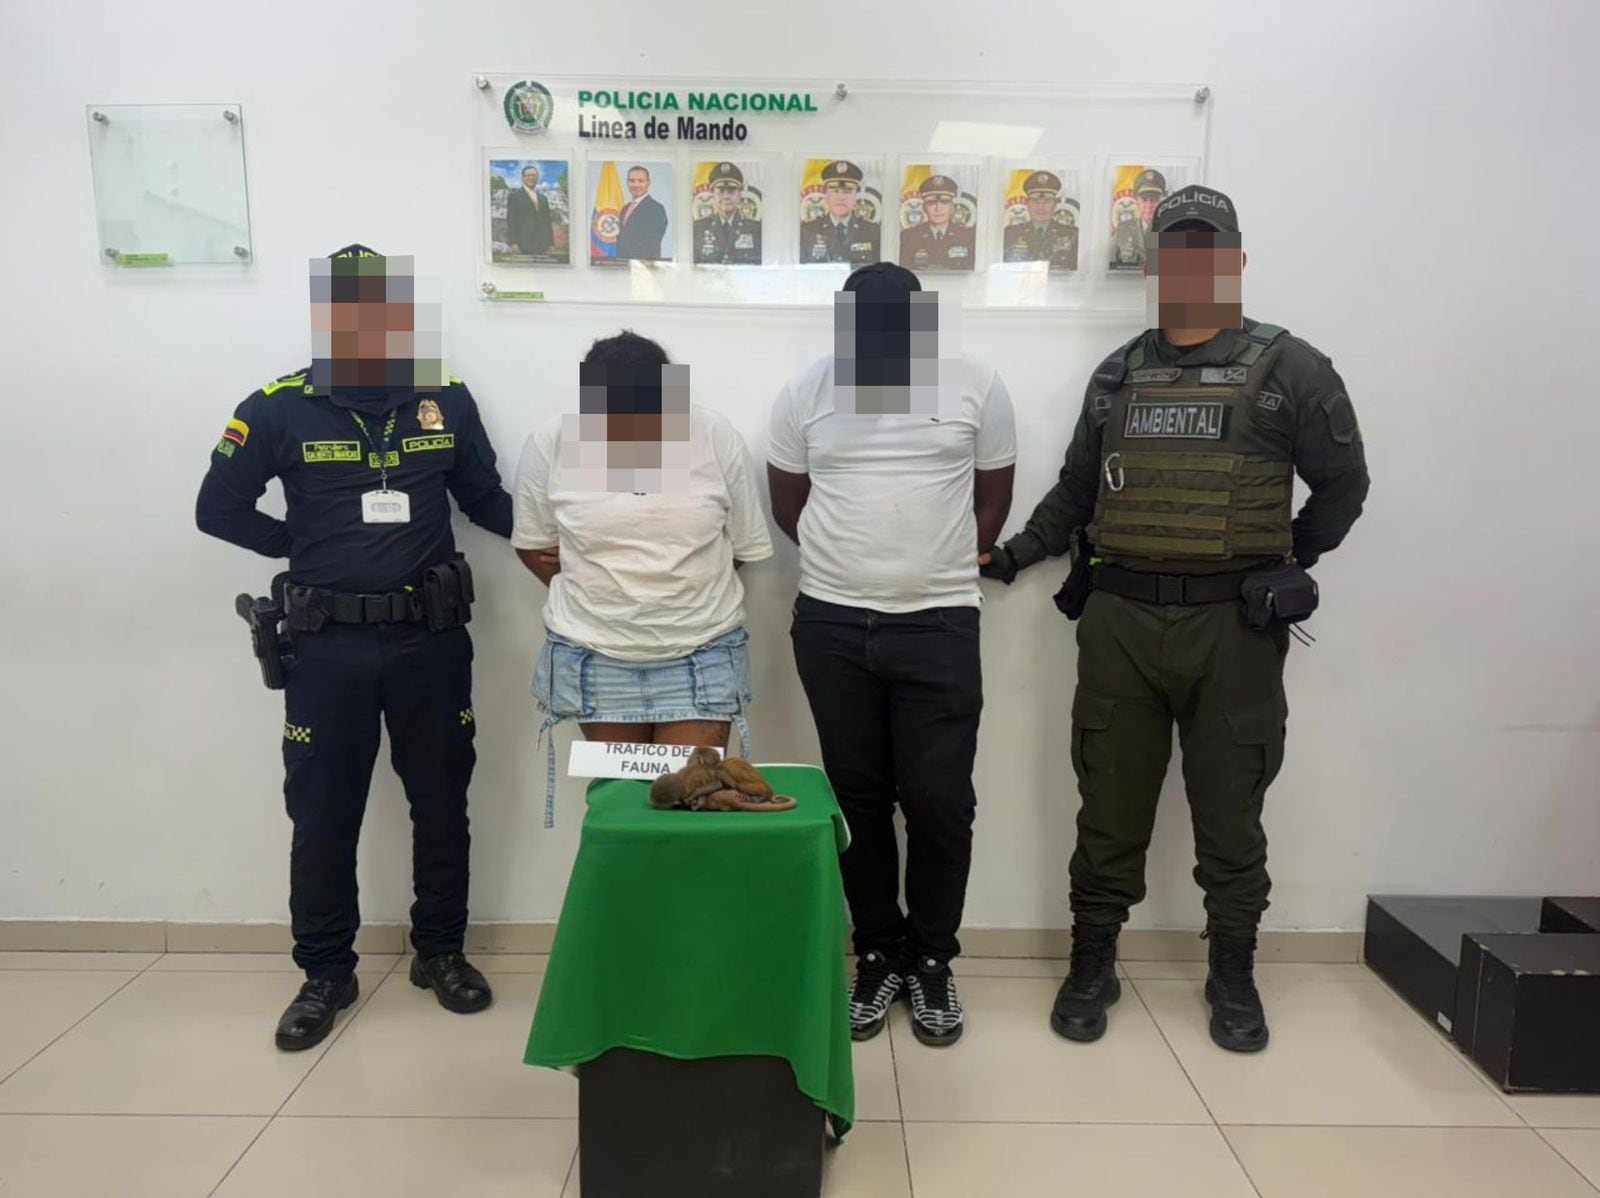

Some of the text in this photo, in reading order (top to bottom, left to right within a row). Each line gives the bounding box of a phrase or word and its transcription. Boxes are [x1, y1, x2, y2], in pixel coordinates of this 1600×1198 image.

[578, 91, 818, 112] POLICIA NACIONAL
[644, 116, 669, 140] de
[677, 116, 748, 141] Mando
[1129, 407, 1217, 434] AMBIENTAL
[671, 746, 690, 758] DE
[621, 761, 670, 774] FAUNA
